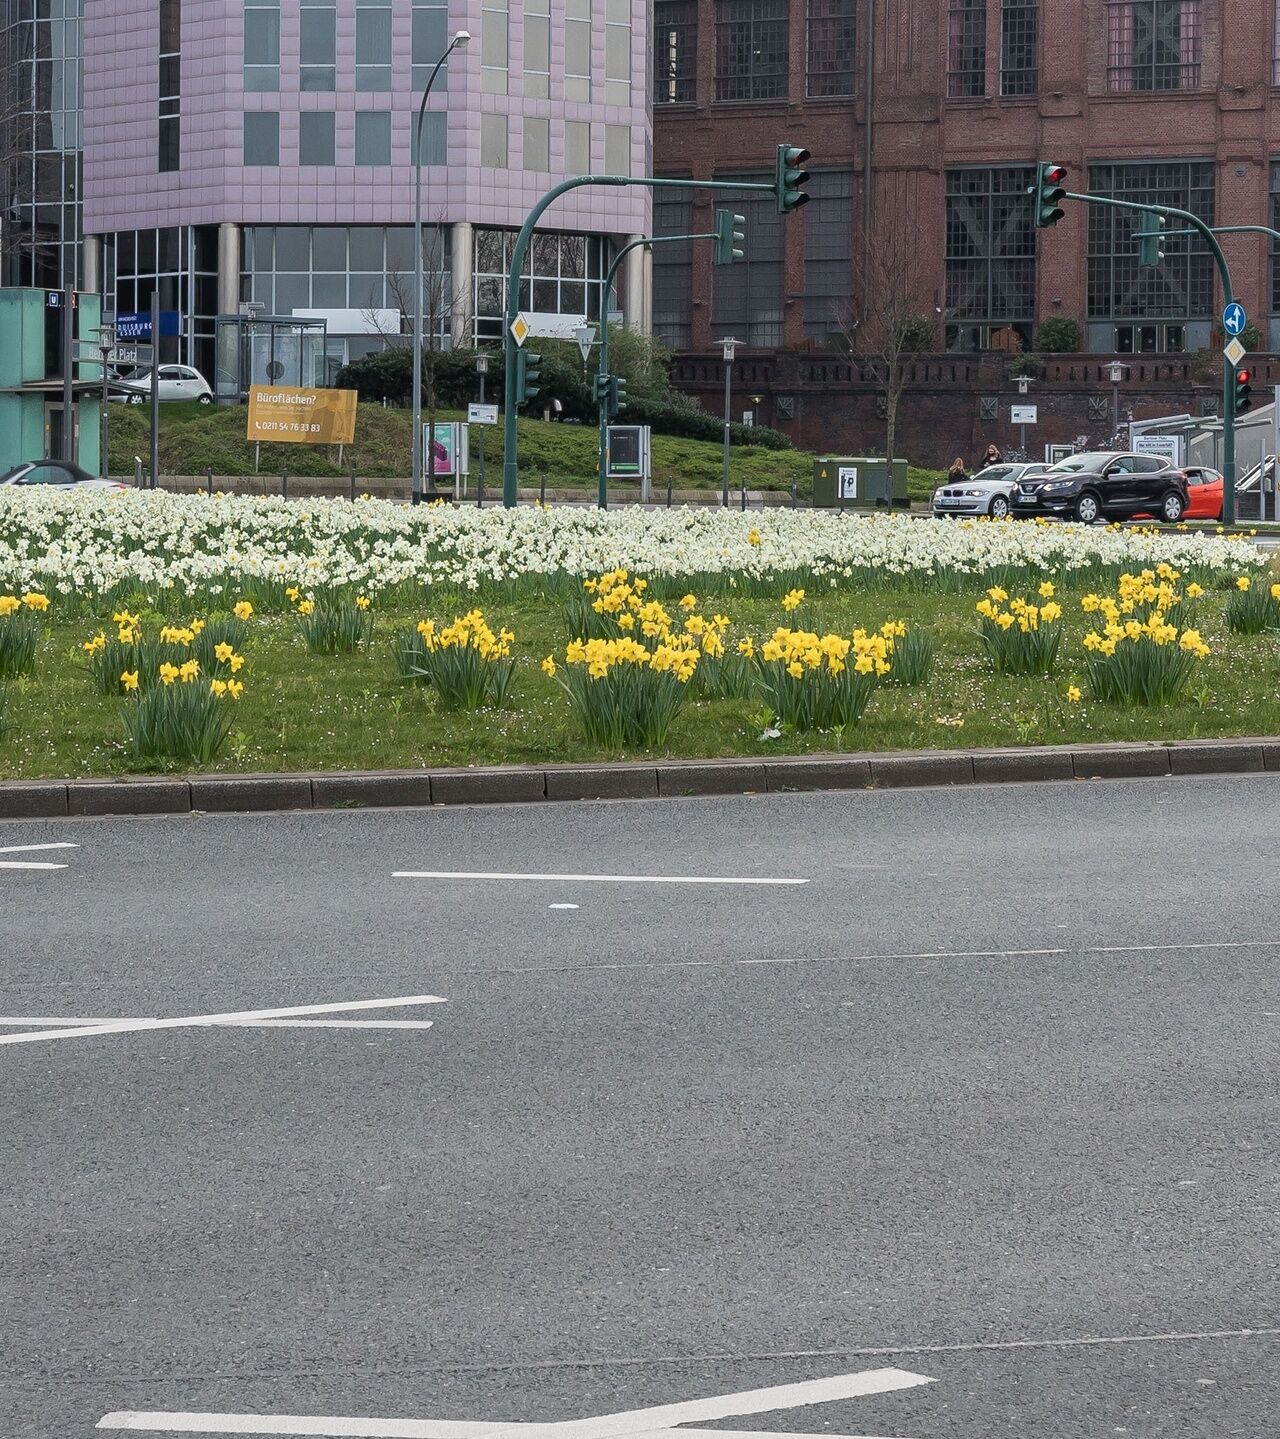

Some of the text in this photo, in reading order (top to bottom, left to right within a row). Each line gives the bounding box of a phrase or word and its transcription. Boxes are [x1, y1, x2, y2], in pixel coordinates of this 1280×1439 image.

[120, 347, 138, 362] Platz
[256, 392, 317, 405] Büroflächen?
[262, 422, 321, 433] 0211 54 76 33 83
